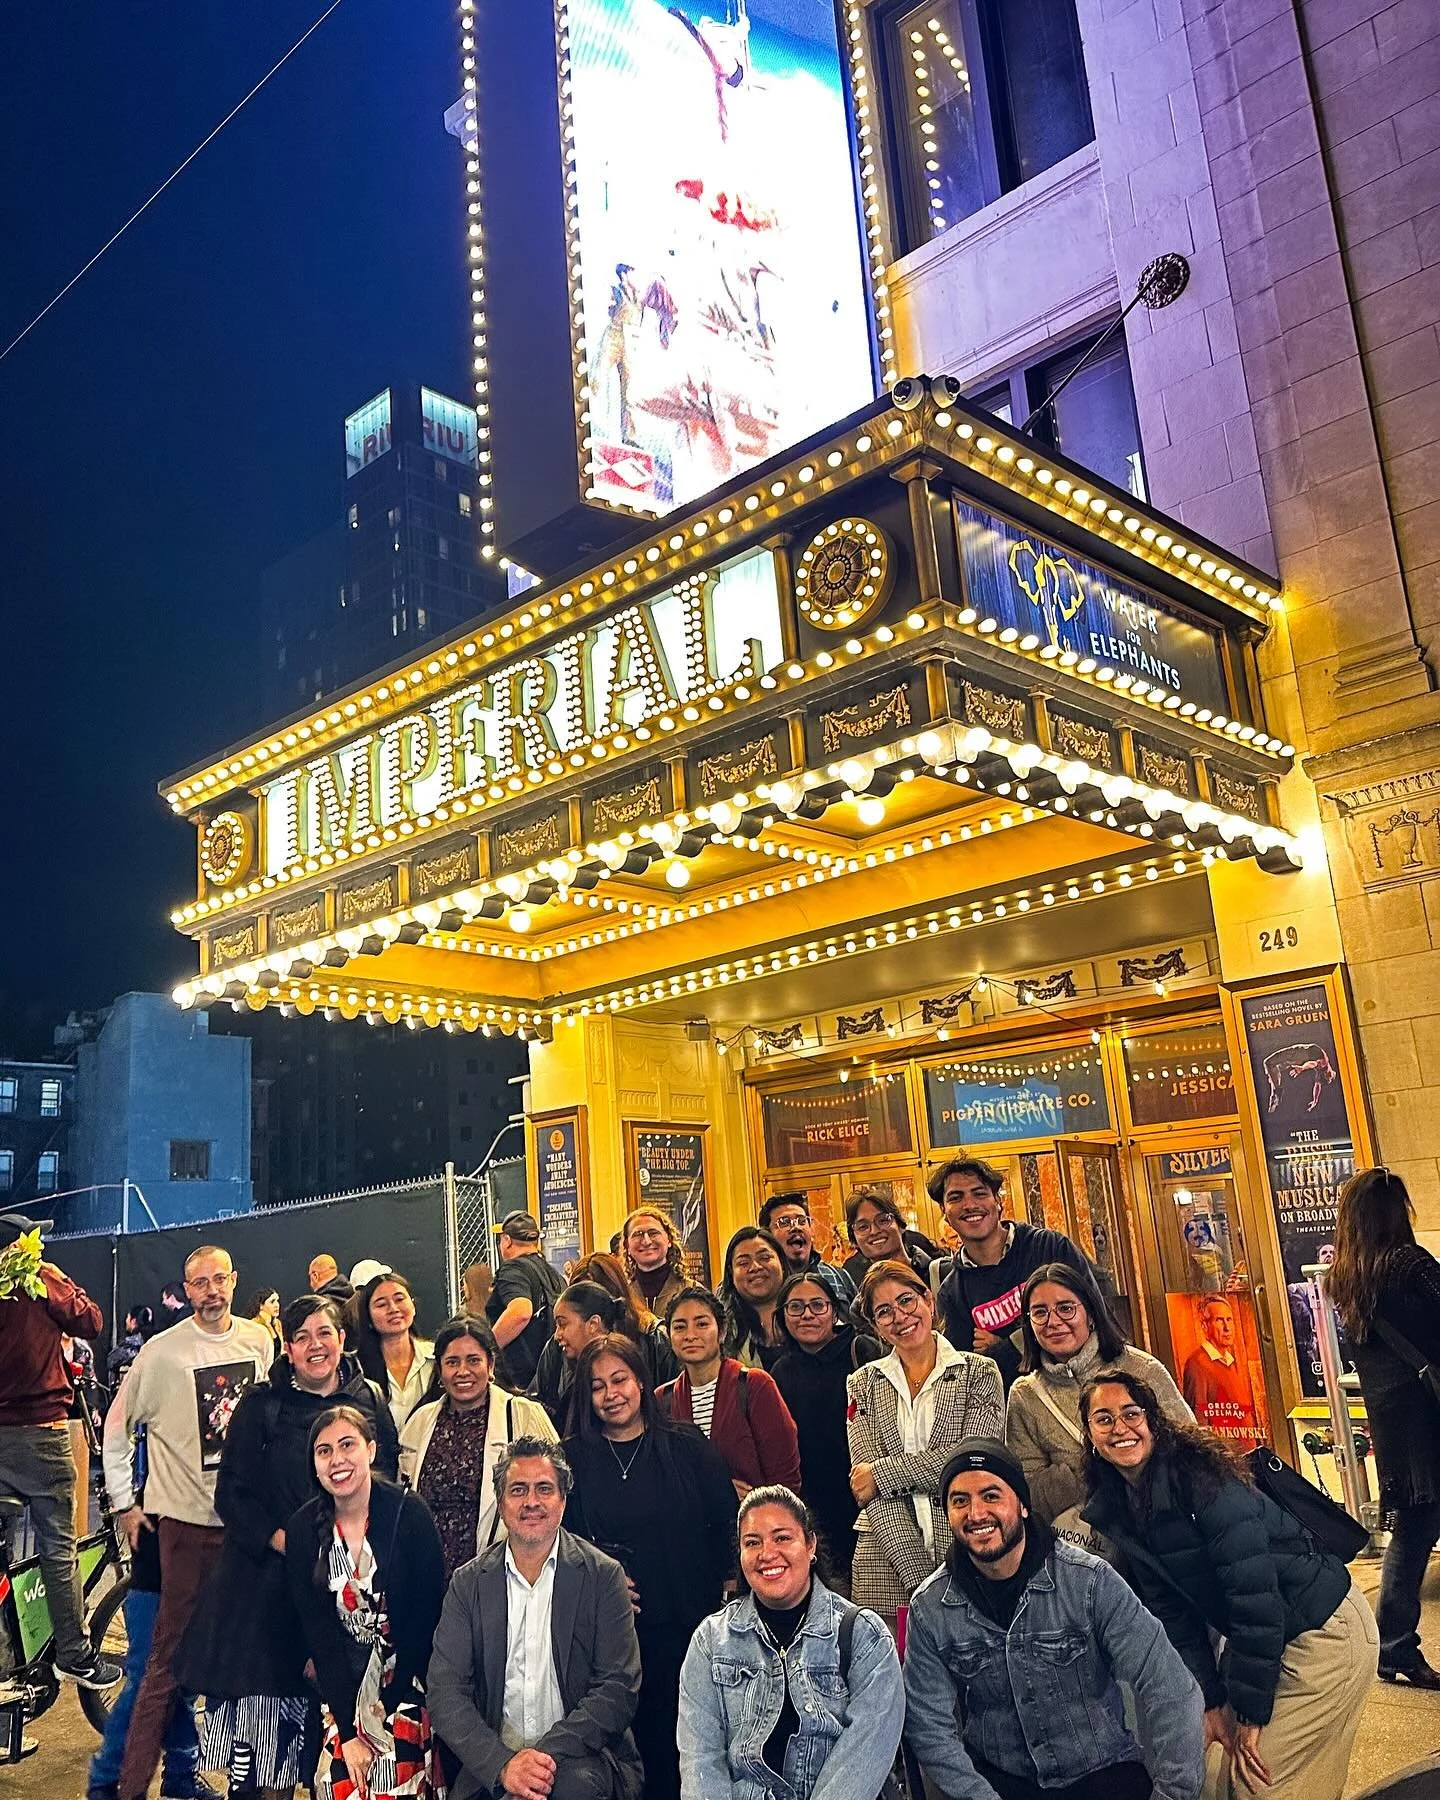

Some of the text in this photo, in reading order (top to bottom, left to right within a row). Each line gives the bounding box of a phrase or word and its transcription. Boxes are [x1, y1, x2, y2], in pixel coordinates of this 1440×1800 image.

[1100, 588, 1158, 634] WATER
[1125, 630, 1141, 646] FOR
[1090, 632, 1180, 690] ELEPHANTS
[267, 570, 766, 856] IMPERIAL
[1259, 925, 1298, 953] 249
[1251, 1008, 1290, 1020] BESTSELLING
[1291, 1004, 1314, 1013] NOVEL
[1263, 1004, 1283, 1012] BASED
[1250, 1010, 1329, 1032] SARA GRUEN
[1067, 1092, 1097, 1108] CO.
[807, 1123, 870, 1143] RICK ELICE
[670, 1147, 695, 1159] UNDER
[646, 1158, 661, 1170] THE
[661, 1159, 675, 1170] BIG
[1292, 1164, 1334, 1187] NEW
[1276, 1185, 1342, 1209] MUSICA
[1280, 1211, 1294, 1223] ON
[1207, 1402, 1239, 1410] GREGG
[1204, 1410, 1245, 1420] EDELMAN
